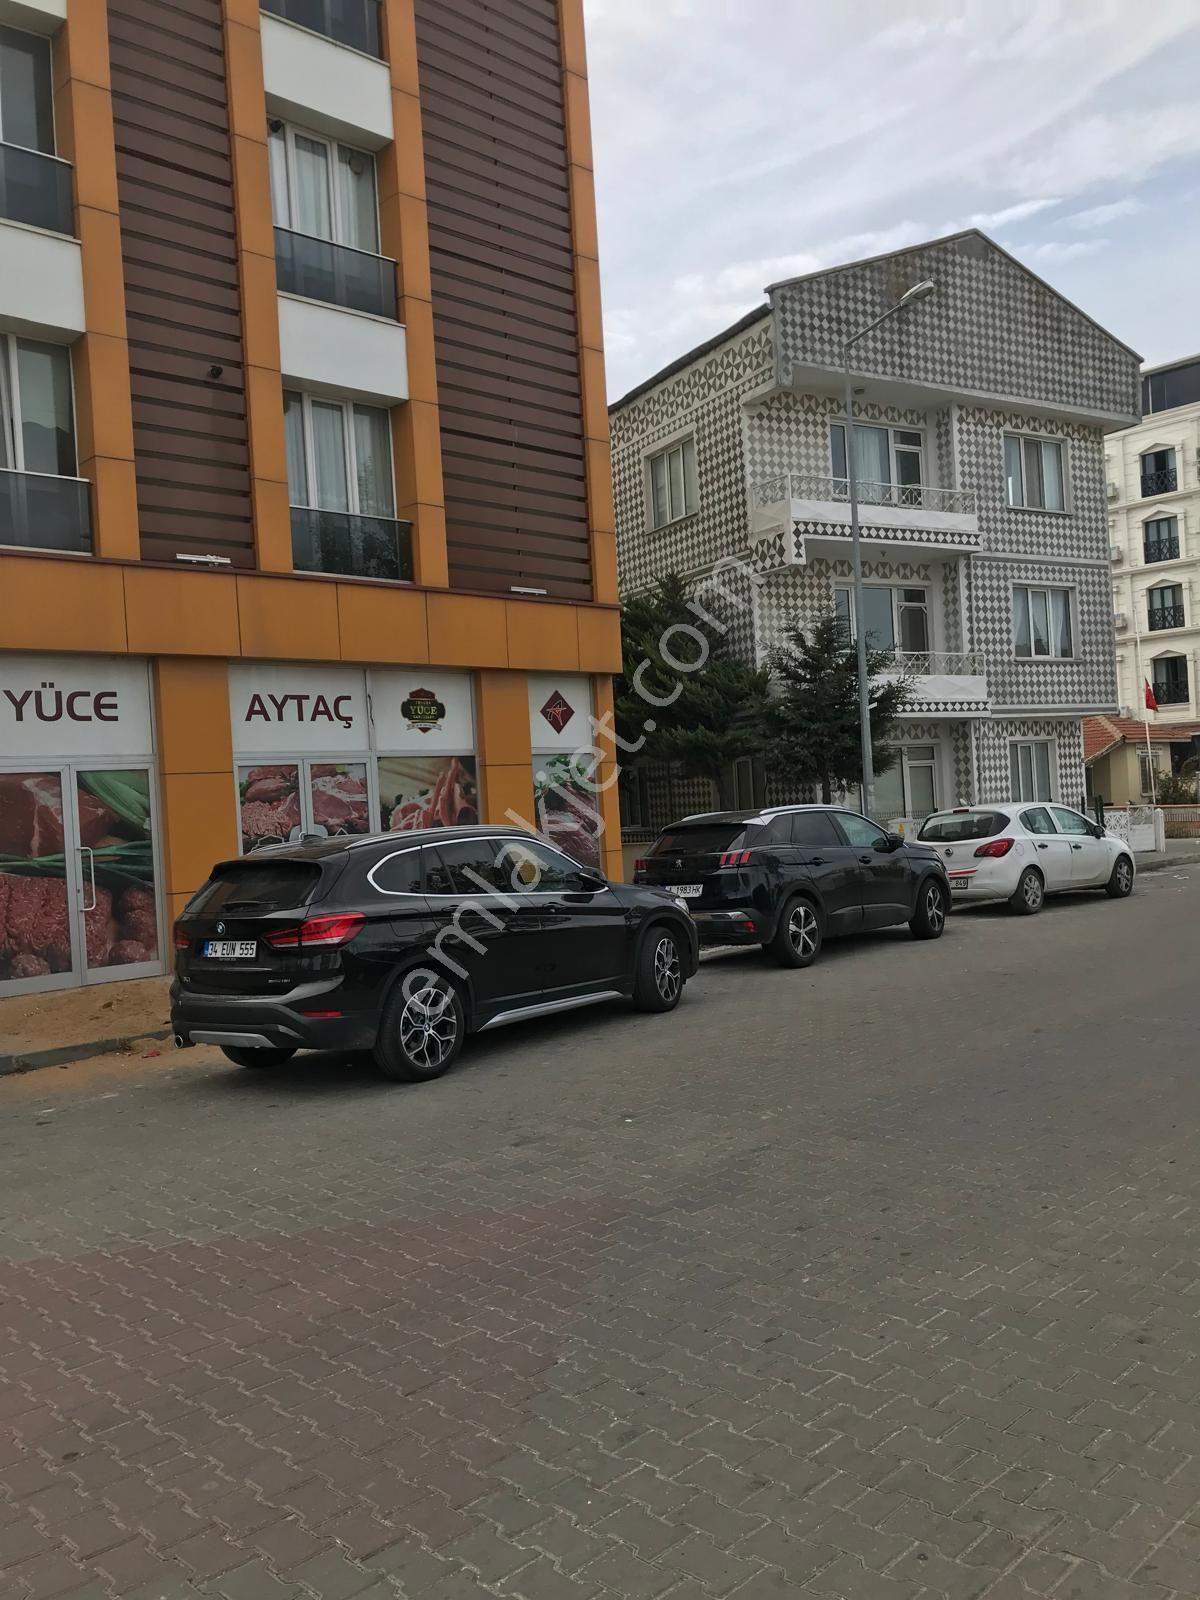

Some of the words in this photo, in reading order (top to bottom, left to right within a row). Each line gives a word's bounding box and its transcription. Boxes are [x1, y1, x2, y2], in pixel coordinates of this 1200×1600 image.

[3, 682, 119, 721] YÜCE
[245, 694, 353, 729] AYTAÇ
[208, 942, 218, 956] 34
[221, 942, 237, 956] EUN
[239, 942, 255, 956] 555
